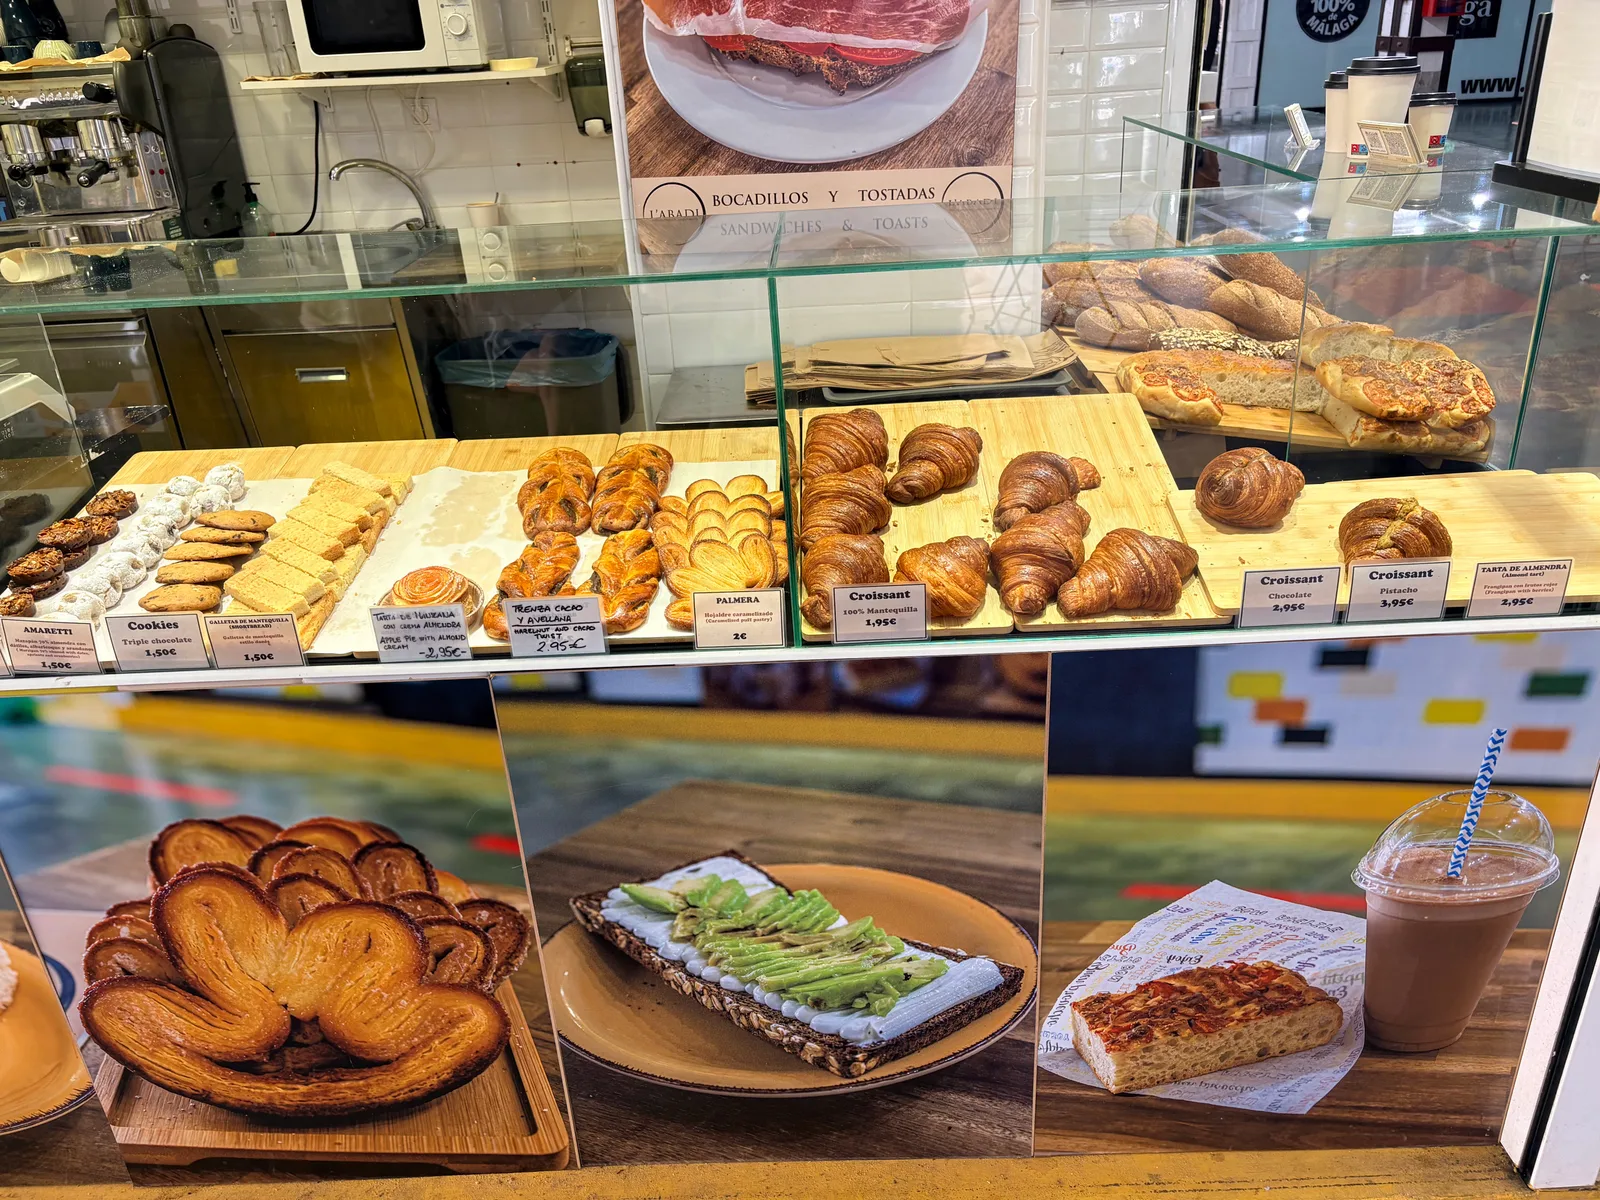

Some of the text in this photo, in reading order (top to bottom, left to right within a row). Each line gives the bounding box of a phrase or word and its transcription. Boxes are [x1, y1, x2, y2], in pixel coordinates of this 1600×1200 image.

[1311, 0, 1355, 13] 100%
[1306, 14, 1359, 36] MÁLAGA
[712, 187, 936, 207] BOCADILLOS Y TOSTADAS
[842, 219, 853, 231] &
[872, 216, 928, 230] TOASTS
[1260, 574, 1324, 585] Croissant
[1369, 569, 1434, 580] Croissant
[849, 590, 911, 601] Croissant
[1380, 598, 1414, 608] 3,95€
[1501, 597, 1534, 607] 2,95€
[512, 604, 583, 613] TRENZA CACAO
[866, 606, 918, 615] Mantequilla
[1272, 603, 1305, 612] 2,95€
[528, 615, 572, 624] AVELLANA
[866, 618, 896, 627] 1,95€
[128, 620, 179, 630] Cookies
[24, 626, 73, 635] AMARETTI
[145, 648, 177, 658] 1,50€
[244, 653, 274, 662] 1,50€
[41, 661, 72, 670] 1,50€
